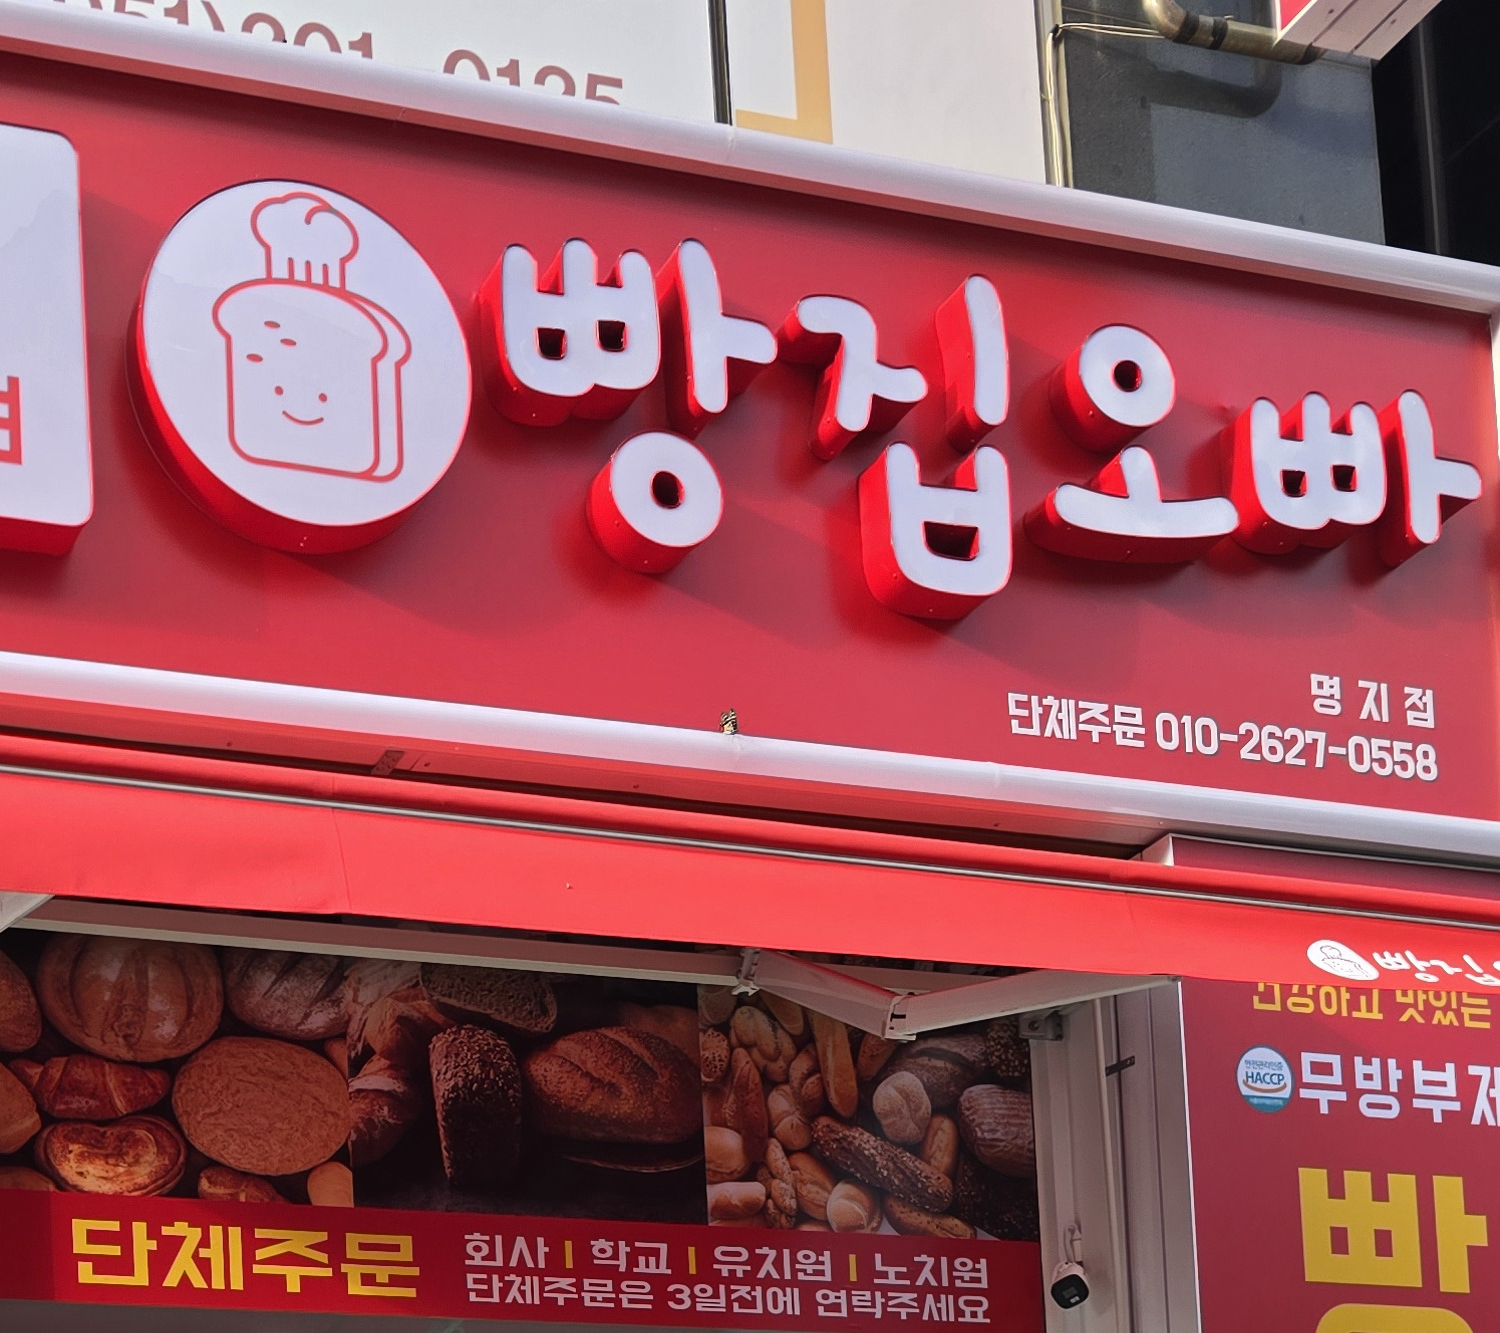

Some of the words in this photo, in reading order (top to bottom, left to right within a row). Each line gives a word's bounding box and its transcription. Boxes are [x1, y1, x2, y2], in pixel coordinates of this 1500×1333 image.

[482, 237, 1483, 615] 빵집오빠
[1007, 692, 1146, 750] 단체주문
[1155, 712, 1439, 781] 010-2627-0558
[1372, 950, 1500, 987] 빵집
[1244, 1070, 1285, 1086] HACCP
[72, 1217, 420, 1298] 단체주문
[463, 1231, 548, 1270] 회사
[590, 1238, 672, 1278] 학교
[711, 1244, 834, 1284] 유치원
[873, 1251, 990, 1291] 노치원
[466, 1272, 653, 1312] 단체주문은
[667, 1281, 801, 1318] 3일전에
[814, 1288, 991, 1326] 연락주세요
